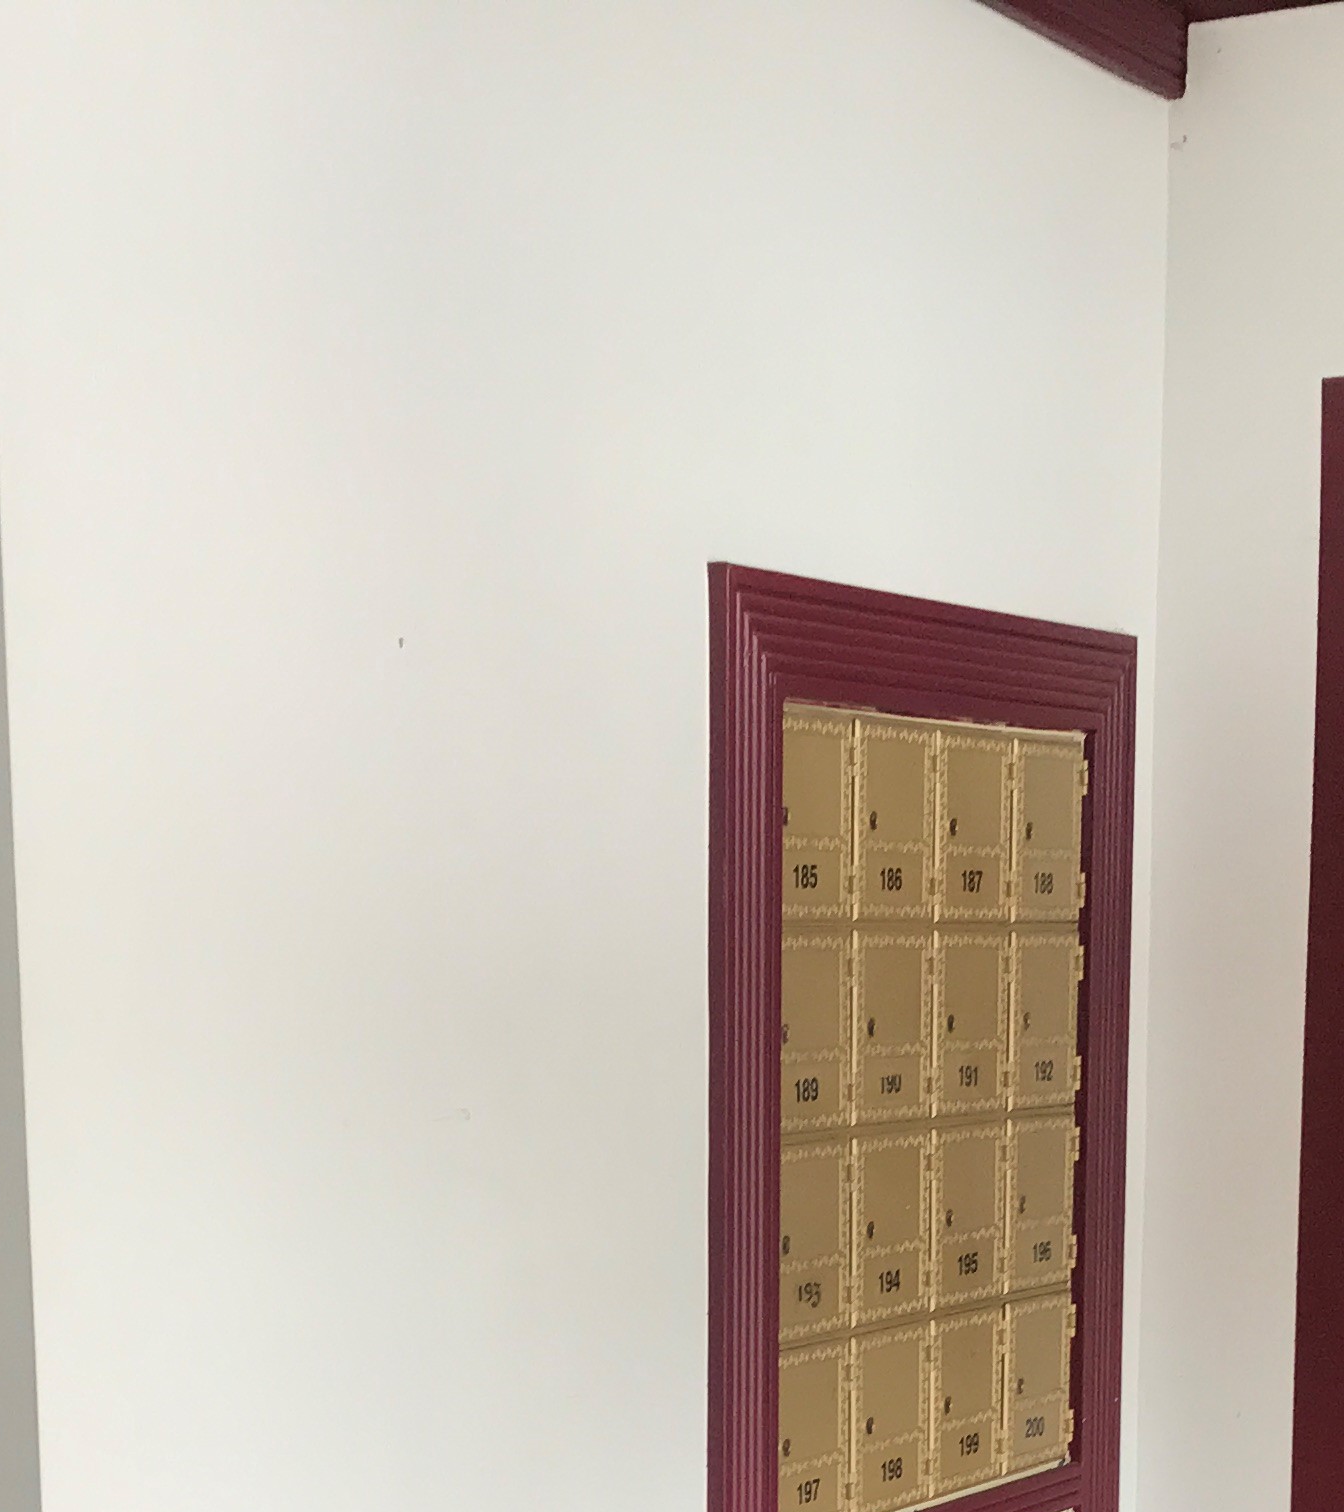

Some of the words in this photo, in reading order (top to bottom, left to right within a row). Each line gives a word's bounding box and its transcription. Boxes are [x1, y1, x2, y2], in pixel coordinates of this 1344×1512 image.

[794, 865, 817, 888] 185
[881, 868, 902, 891] 186
[962, 870, 983, 892] 187
[1034, 873, 1053, 894] 188
[959, 1065, 978, 1087] 191
[1035, 1060, 1053, 1081] 192
[795, 1078, 818, 1102] 189
[1033, 1241, 1051, 1262] 196
[958, 1252, 978, 1275] 195
[879, 1270, 900, 1292] 194
[1025, 1417, 1044, 1438] 200
[959, 1433, 979, 1455] 199
[882, 1457, 902, 1481] 198
[797, 1478, 820, 1504] 197
